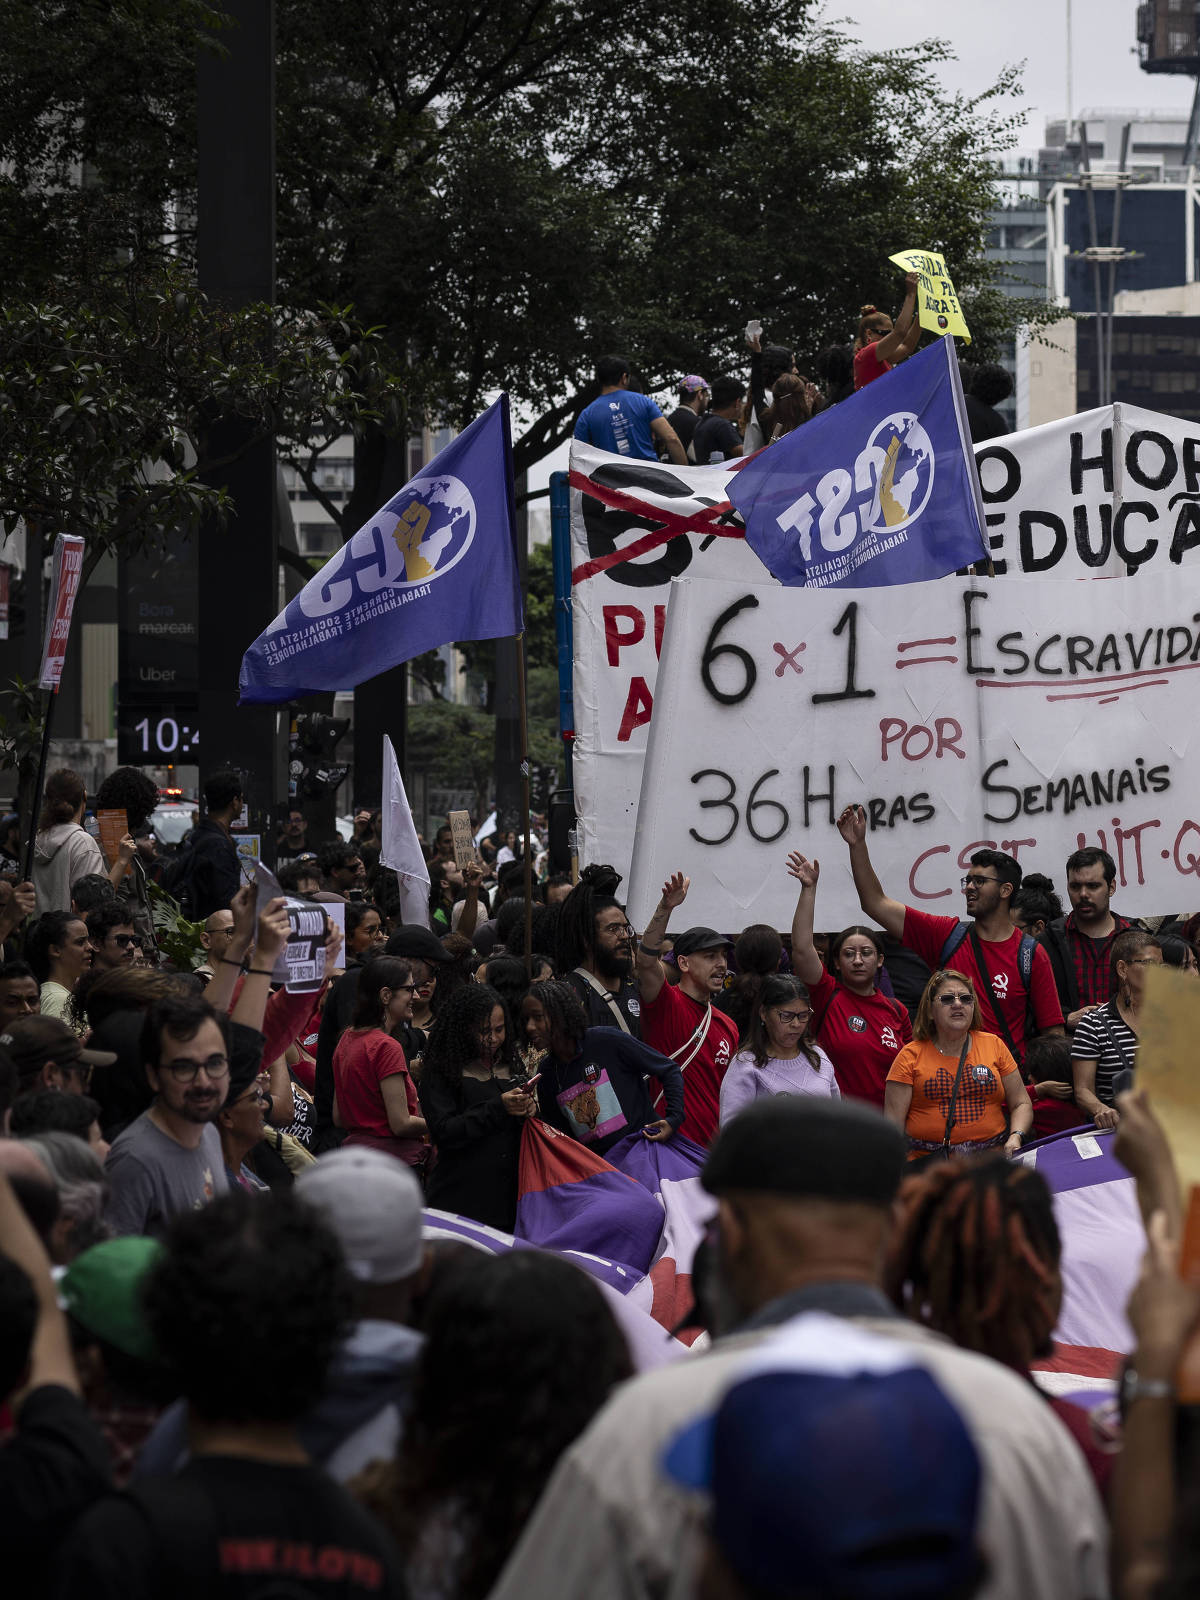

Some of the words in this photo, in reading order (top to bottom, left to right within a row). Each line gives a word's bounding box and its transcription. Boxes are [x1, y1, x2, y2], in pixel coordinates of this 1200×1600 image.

[139, 667, 176, 681] Uber
[880, 718, 965, 761] POR
[689, 769, 789, 845] 36
